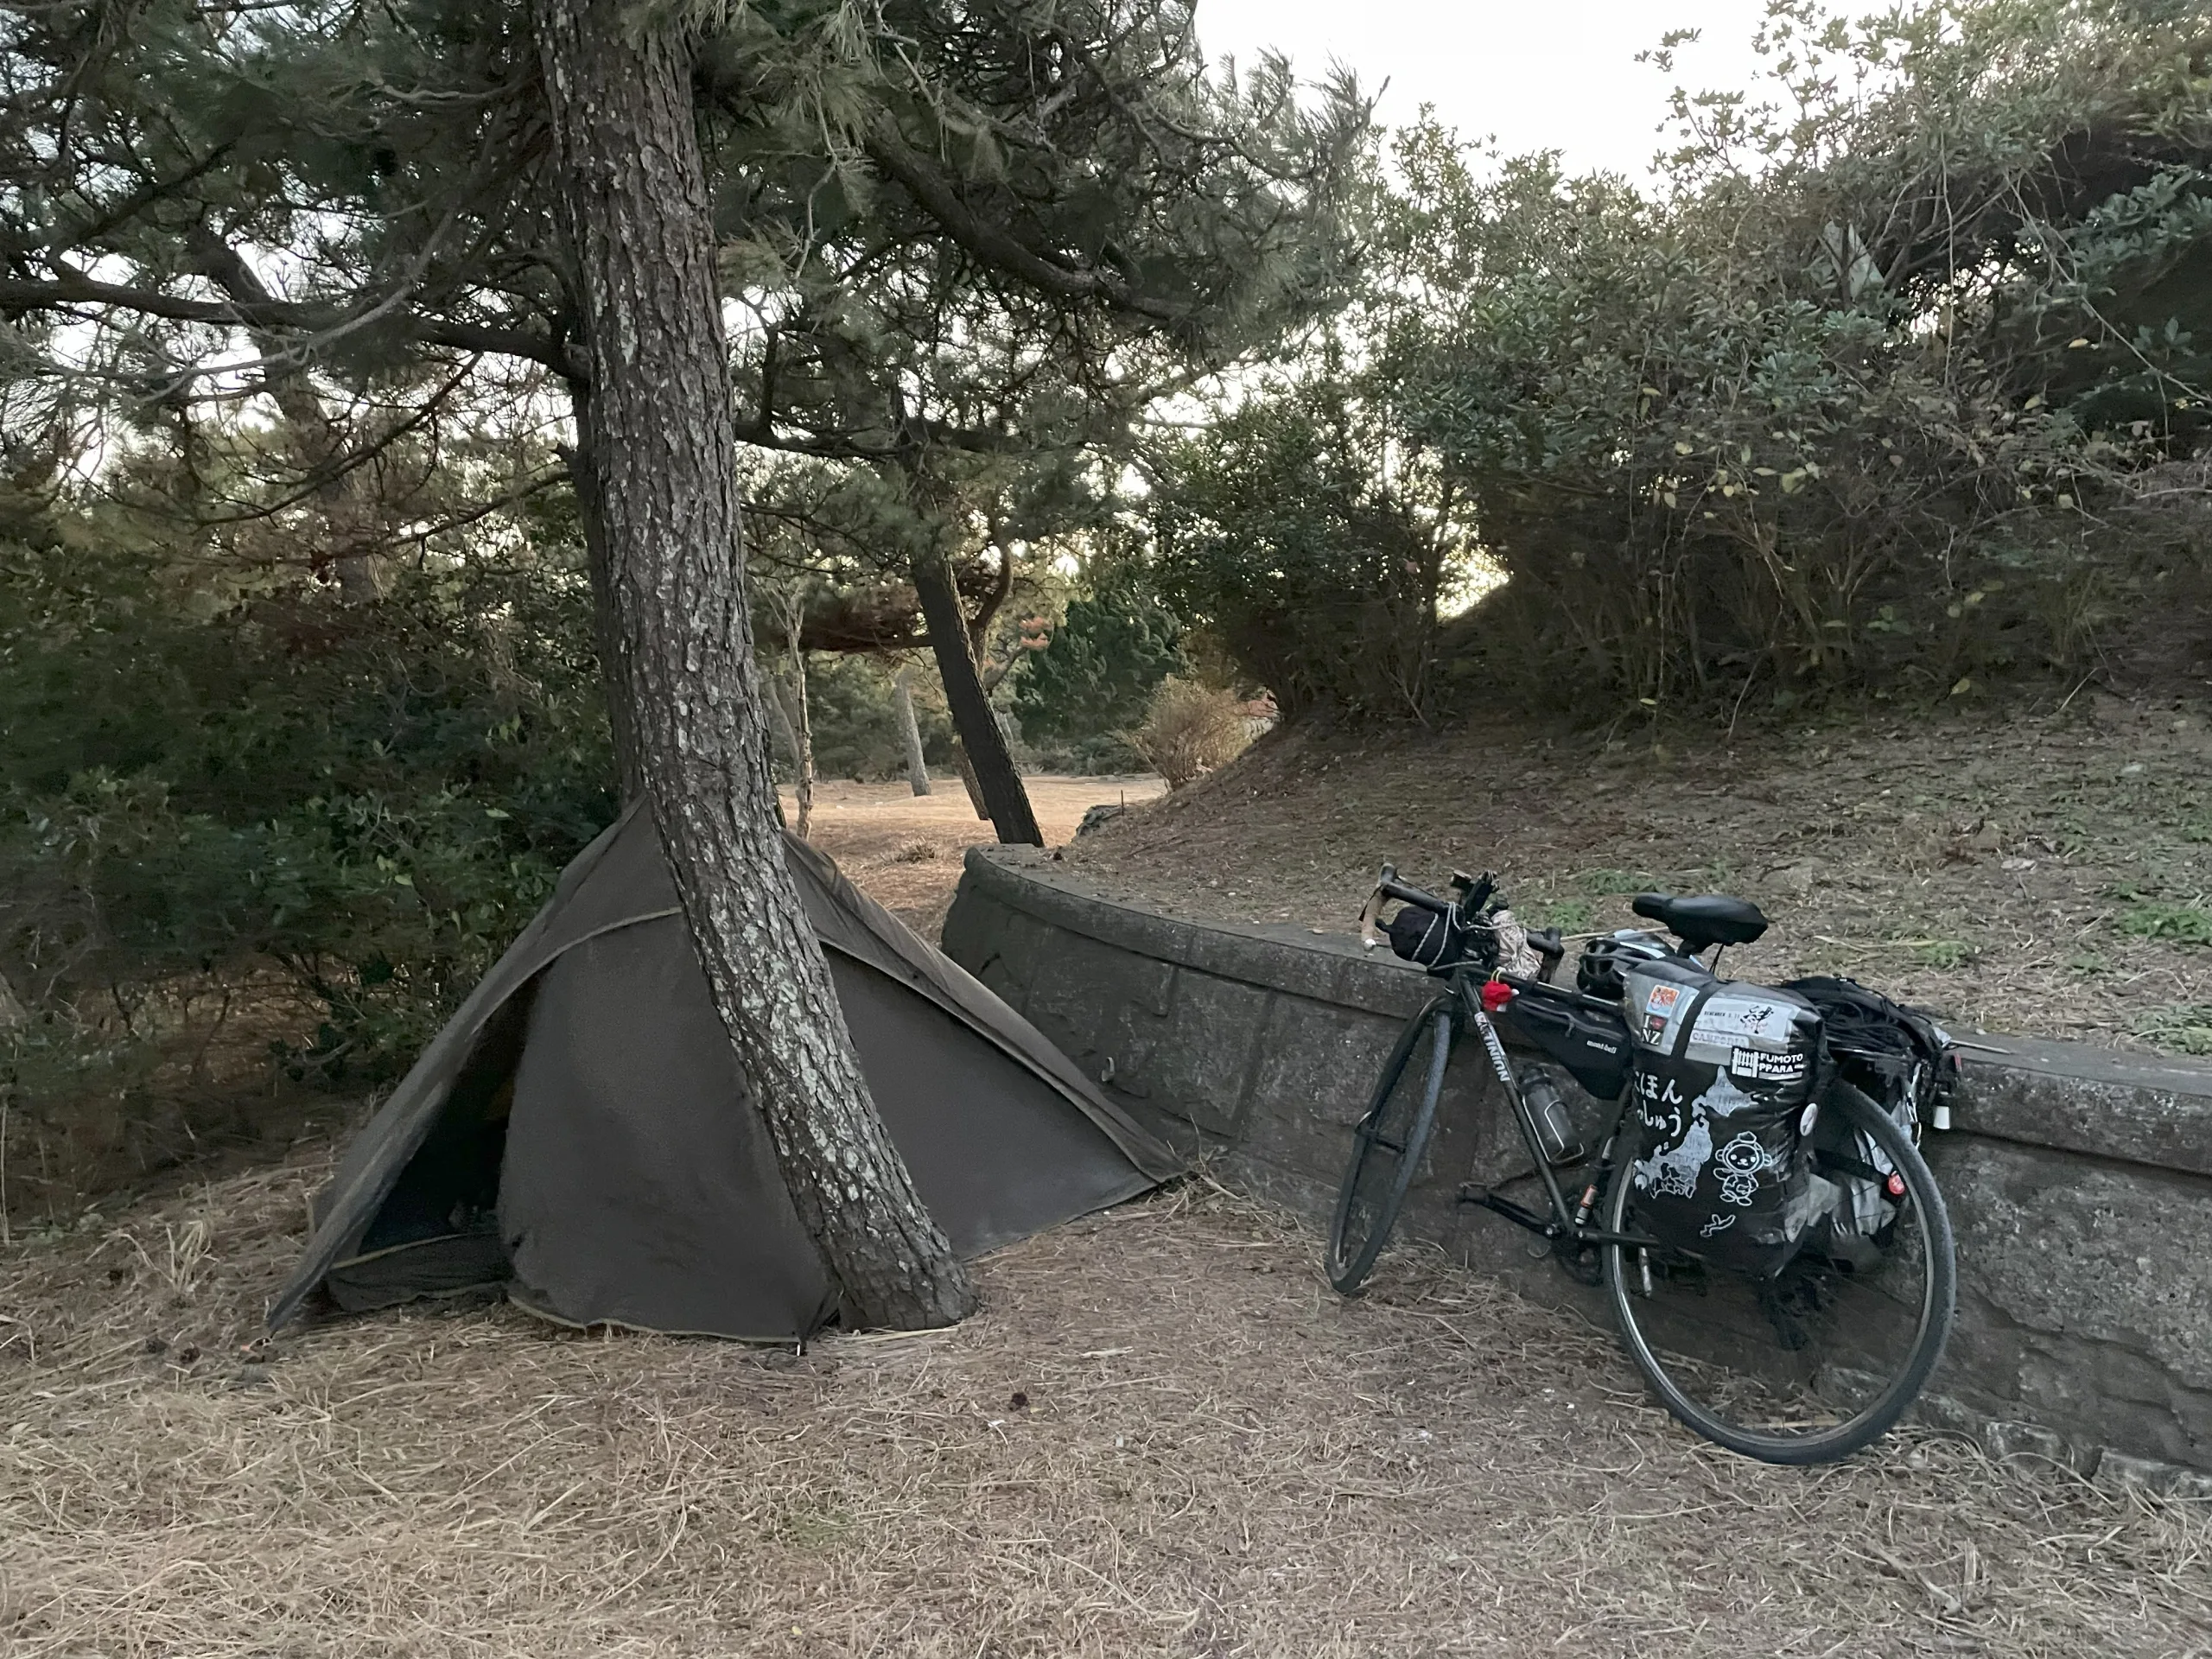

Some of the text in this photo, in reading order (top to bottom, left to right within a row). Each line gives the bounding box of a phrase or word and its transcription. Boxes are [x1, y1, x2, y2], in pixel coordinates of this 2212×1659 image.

[1643, 1014, 1650, 1028] I
[1642, 1028, 1661, 1046] NZ
[1759, 1052, 1803, 1064] FUMOTO
[1758, 1062, 1794, 1073] PPARA
